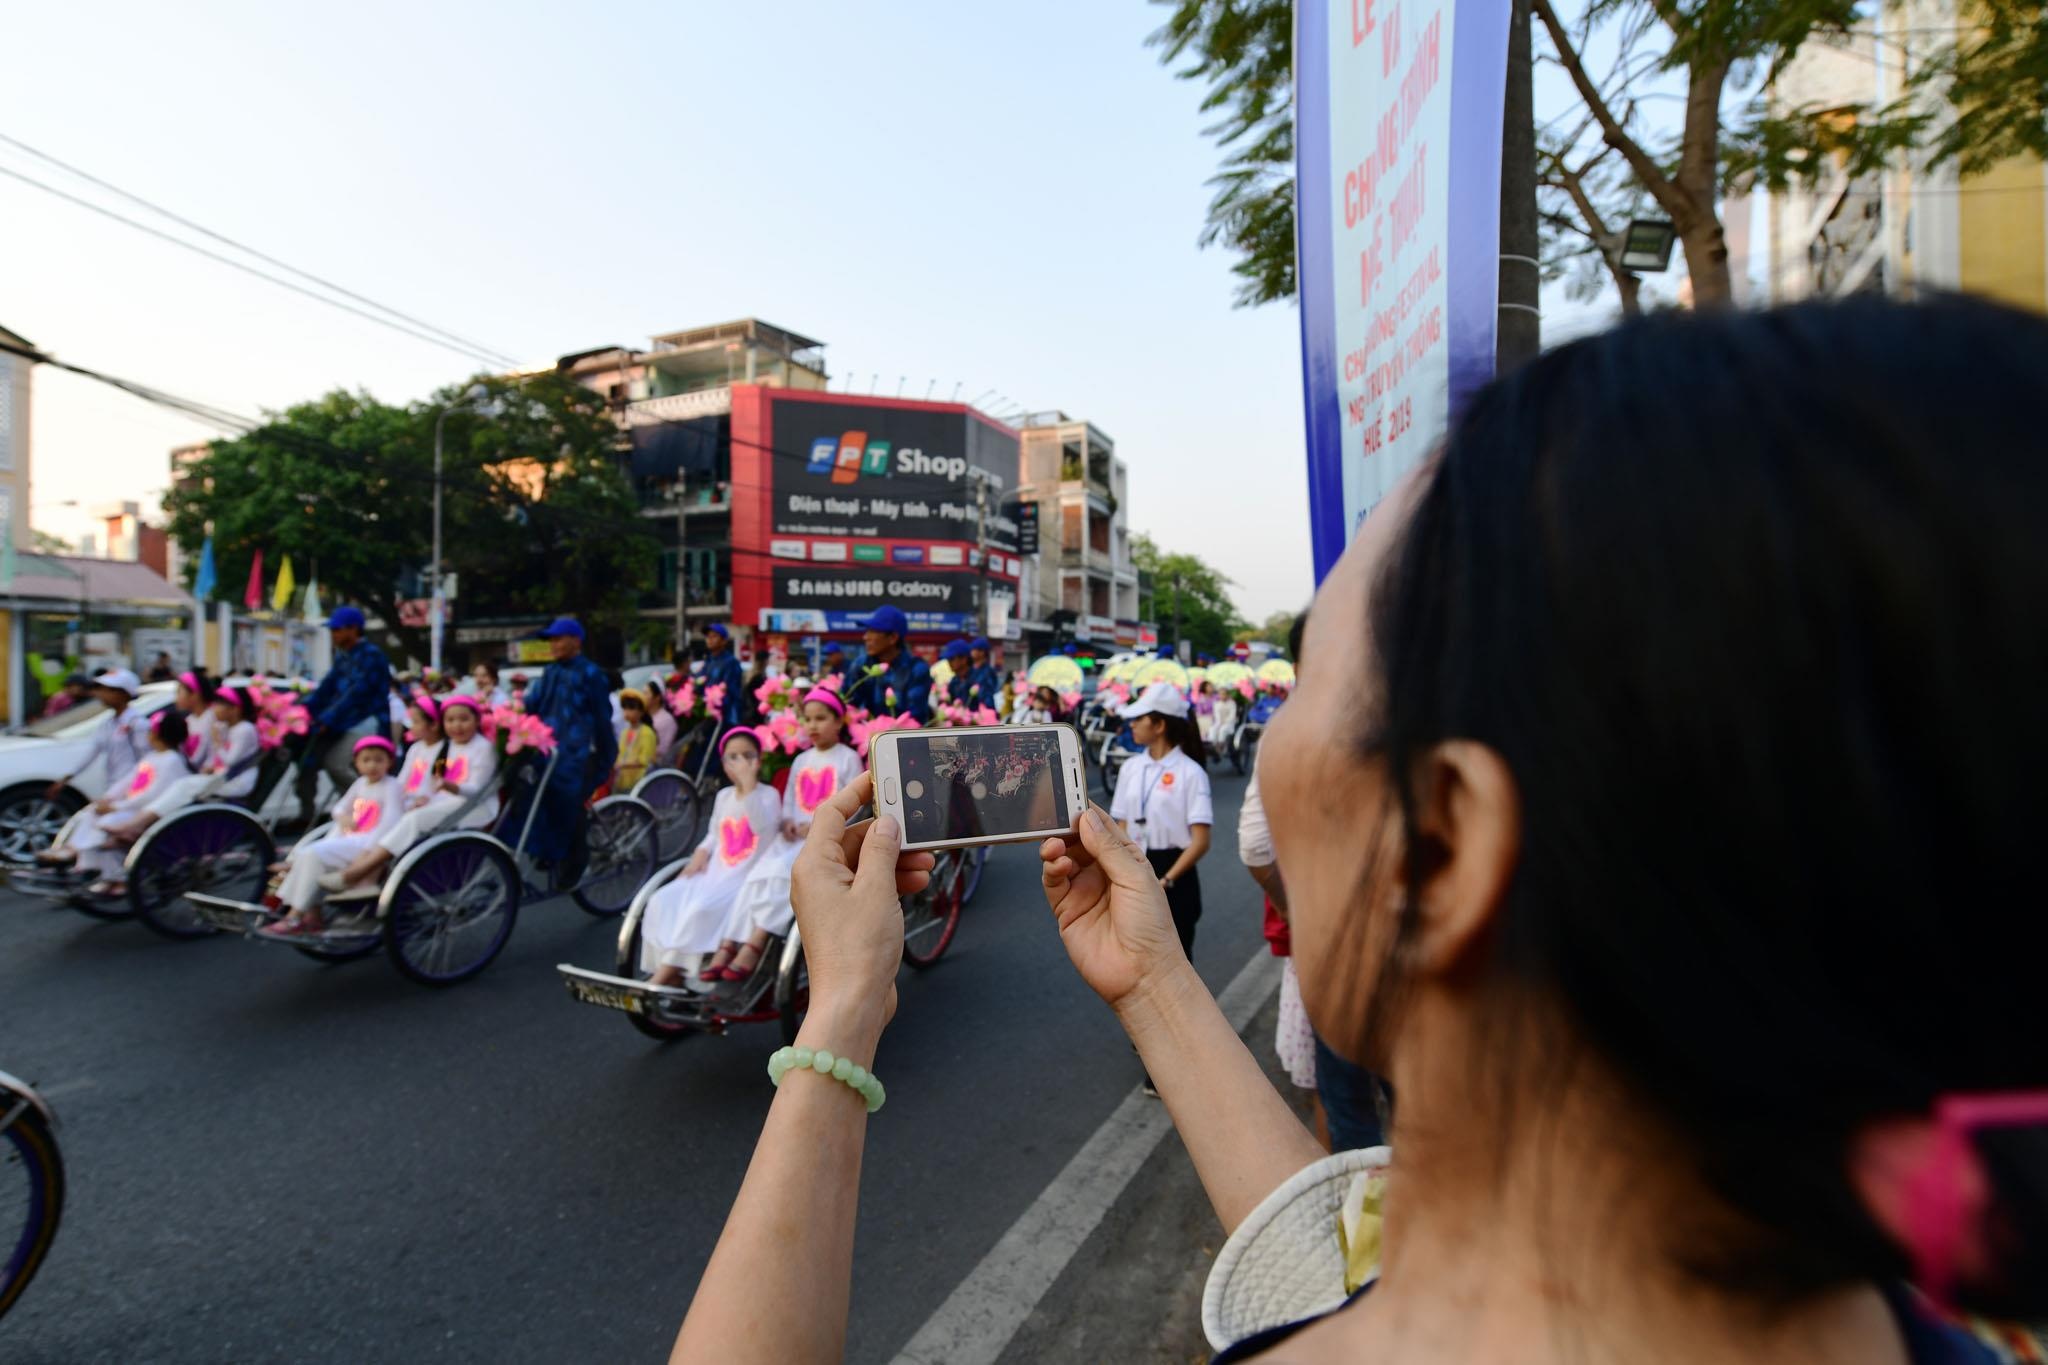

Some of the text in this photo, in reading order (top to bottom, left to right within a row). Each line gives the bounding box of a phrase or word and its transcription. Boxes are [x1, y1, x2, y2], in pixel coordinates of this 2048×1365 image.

[1362, 402, 1383, 458] HUẾ
[896, 447, 967, 482] Shop
[787, 578, 884, 596] SAMSUNG
[887, 580, 953, 601] Galaxy
